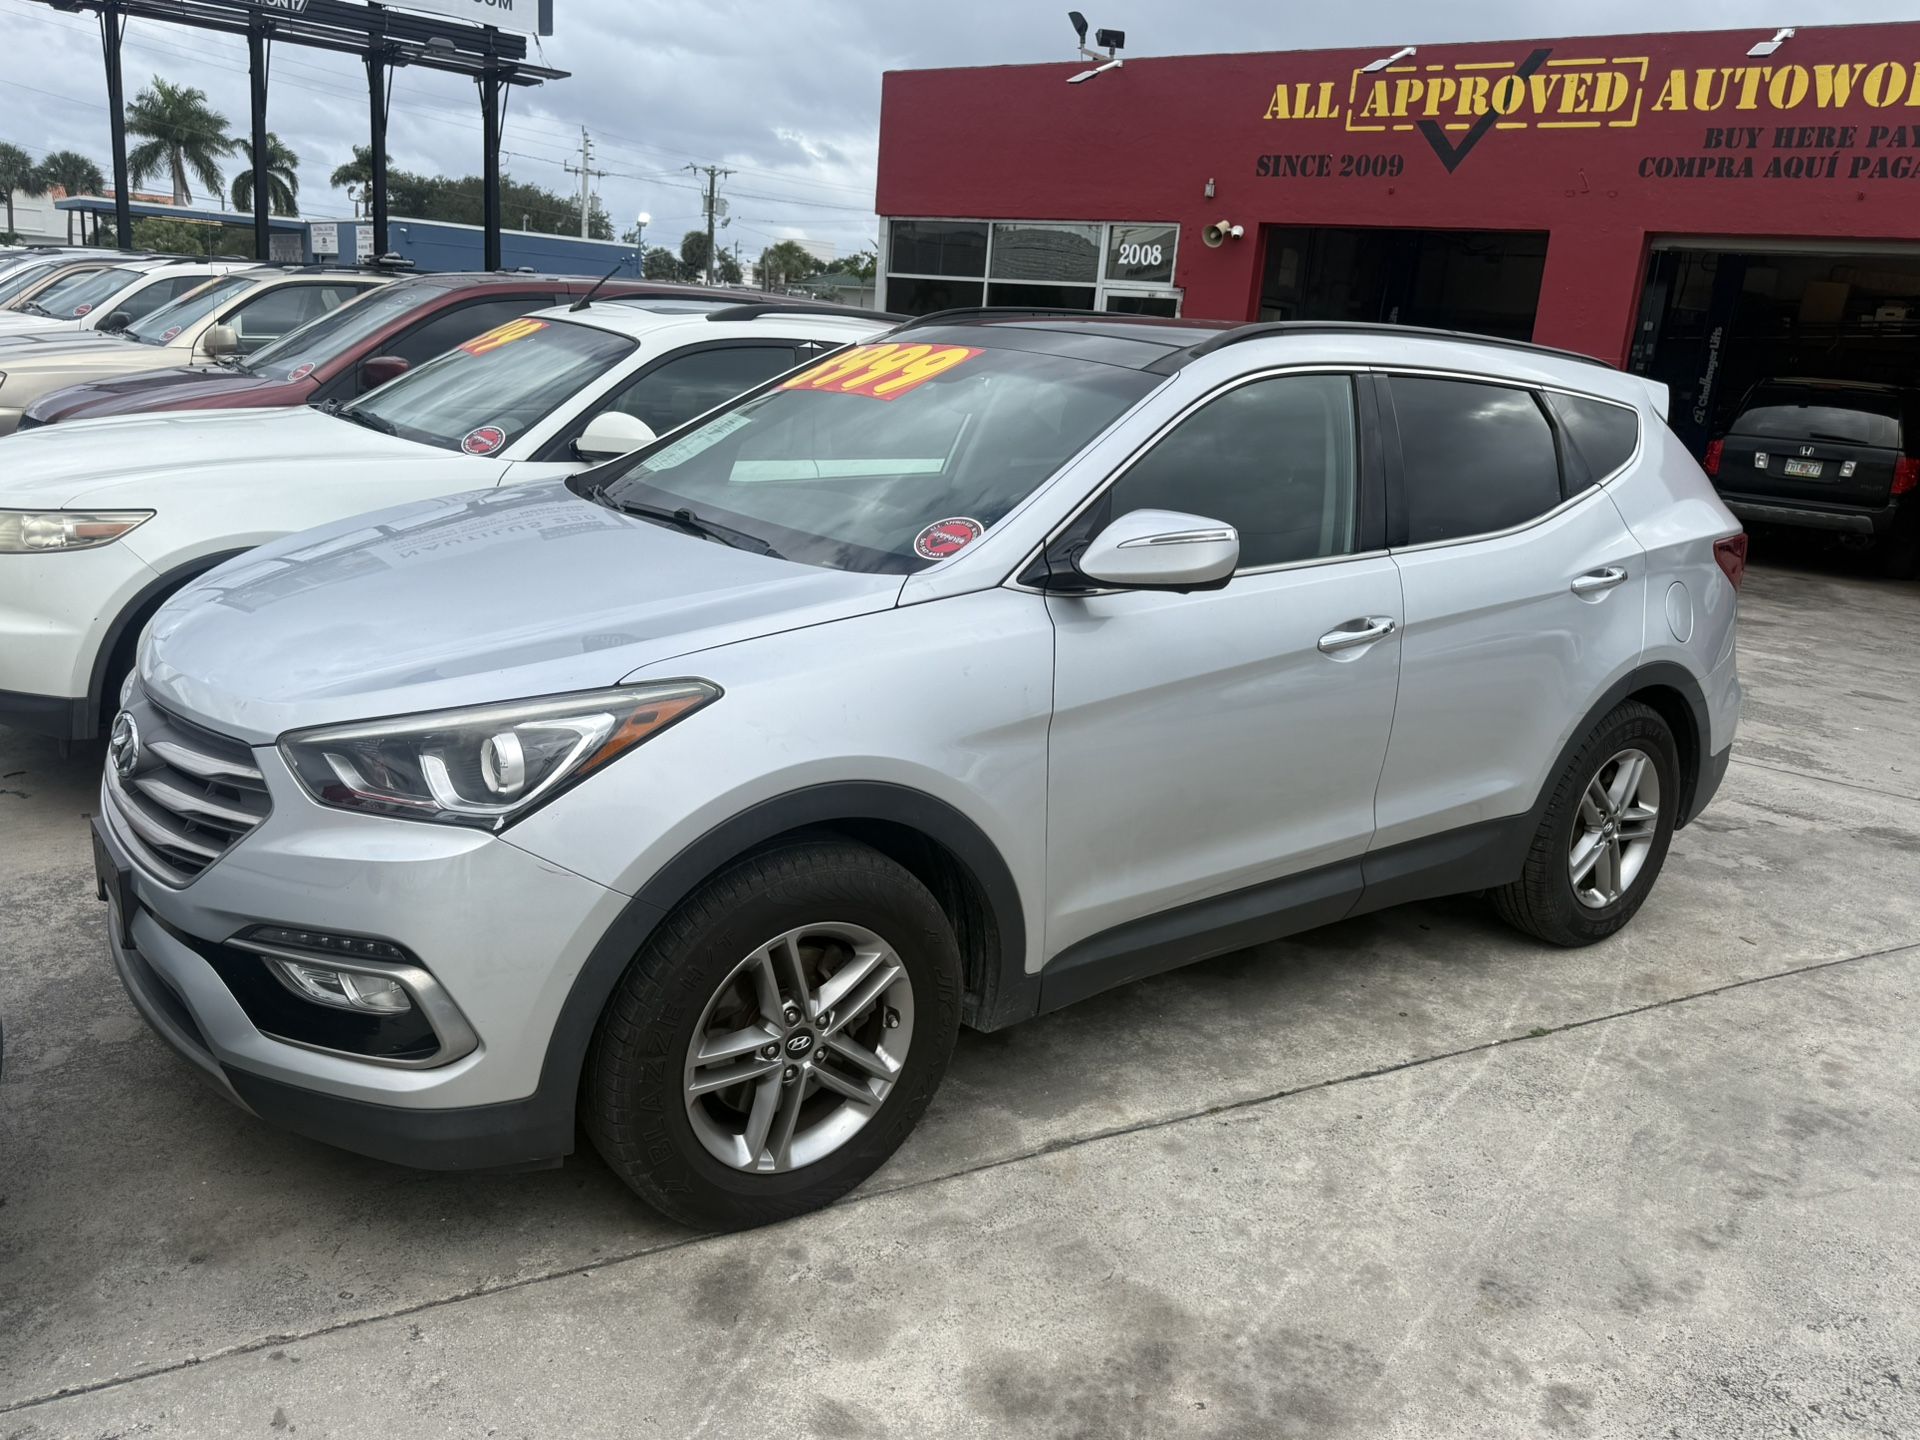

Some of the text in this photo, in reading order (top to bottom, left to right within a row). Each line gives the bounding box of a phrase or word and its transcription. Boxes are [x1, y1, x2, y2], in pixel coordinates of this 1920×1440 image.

[1263, 82, 1340, 120] ALL
[1359, 71, 1630, 118] APPROVED
[1703, 127, 1764, 149] BUY
[1772, 126, 1857, 149] HERE
[1255, 153, 1404, 177] SINCE 2009
[1638, 156, 1754, 178] COMPRA
[1763, 151, 1840, 178] AQUÍ
[1118, 243, 1162, 266] 2008
